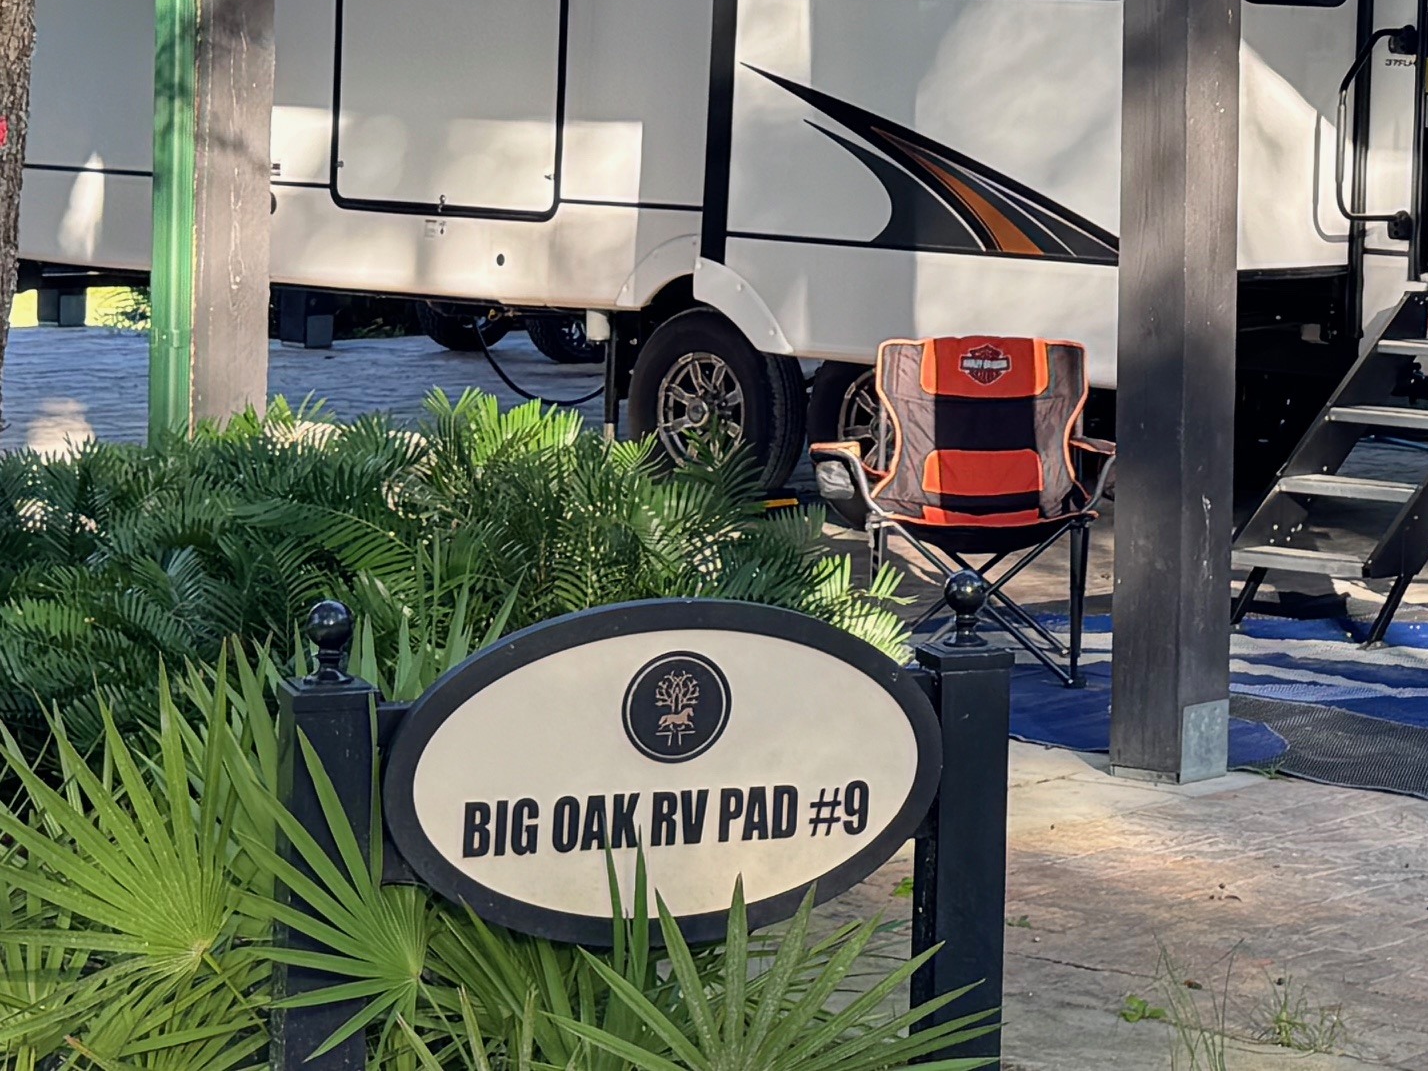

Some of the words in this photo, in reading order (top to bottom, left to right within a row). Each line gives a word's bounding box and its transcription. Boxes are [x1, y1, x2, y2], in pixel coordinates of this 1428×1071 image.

[462, 797, 539, 858] BIG
[552, 792, 640, 853] OAK
[650, 789, 709, 847] RV
[718, 785, 798, 842] PAD
[809, 780, 870, 838] #9
